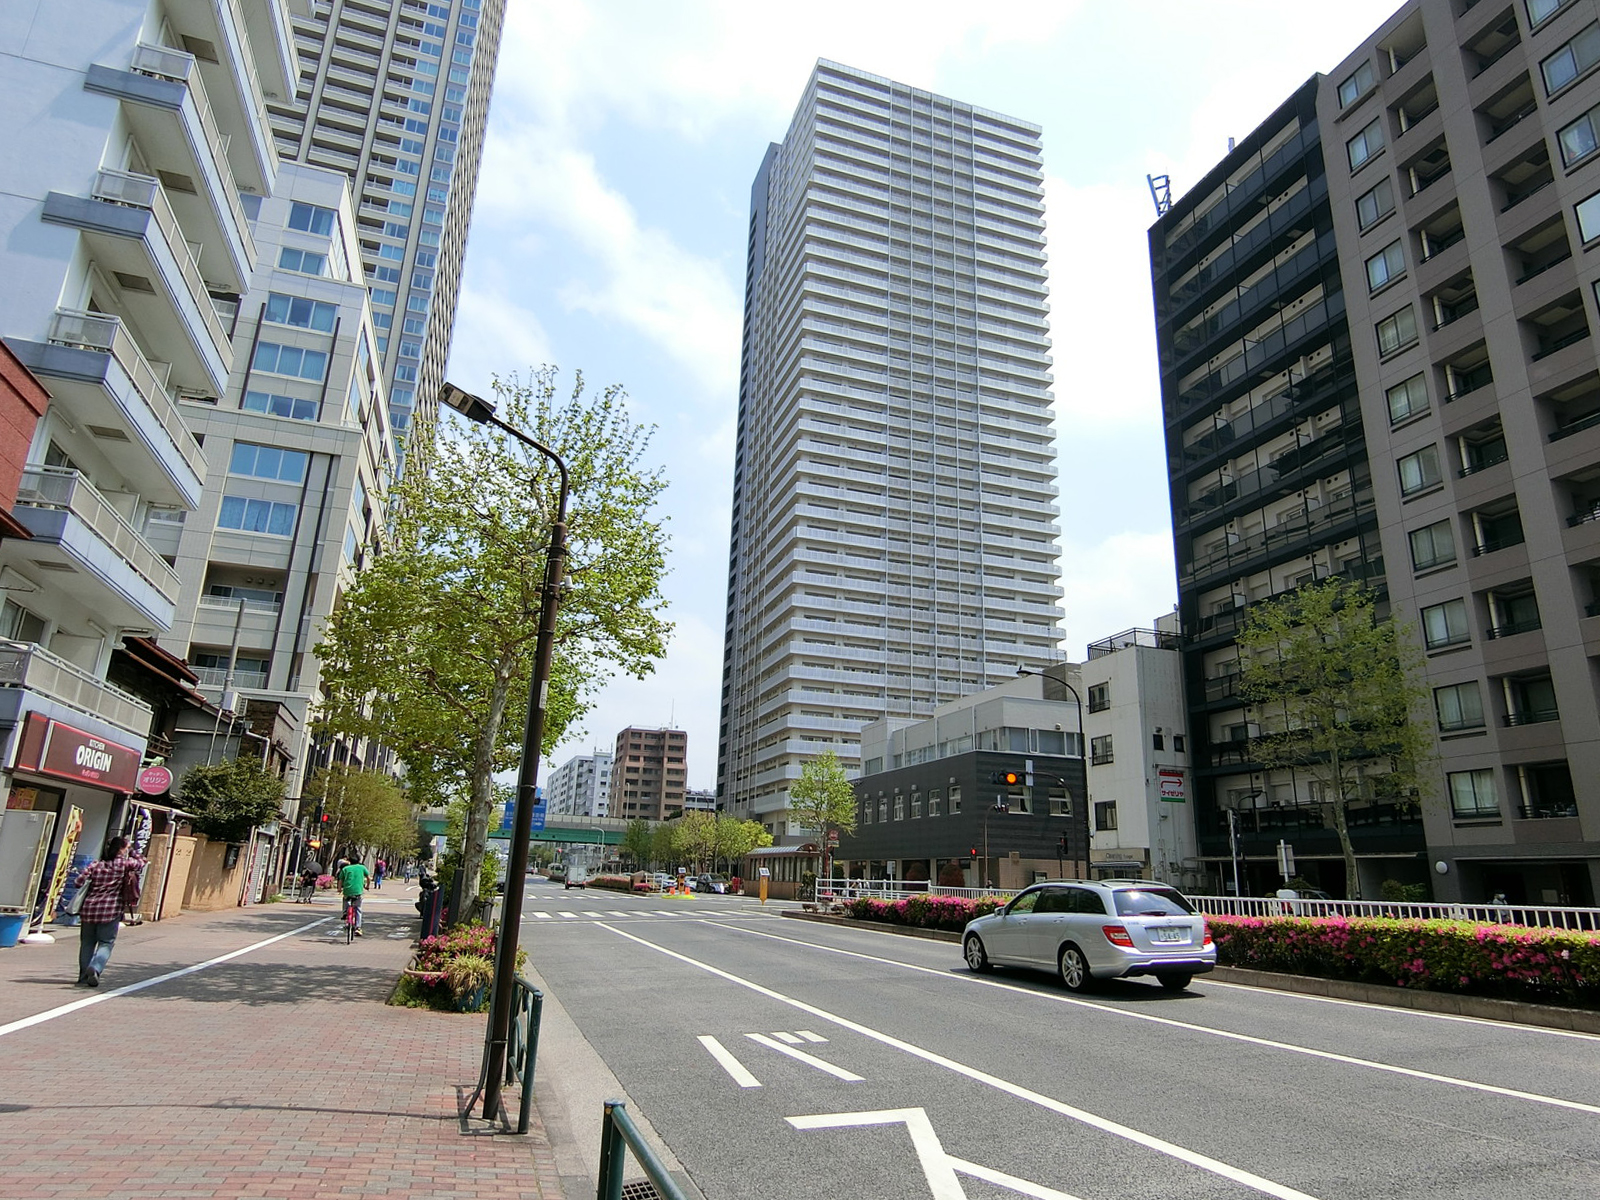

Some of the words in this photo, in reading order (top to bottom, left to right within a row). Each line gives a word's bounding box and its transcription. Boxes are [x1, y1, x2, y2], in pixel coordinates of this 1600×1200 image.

[76, 744, 113, 772] ORIGIN
[142, 776, 167, 784] オリジン
